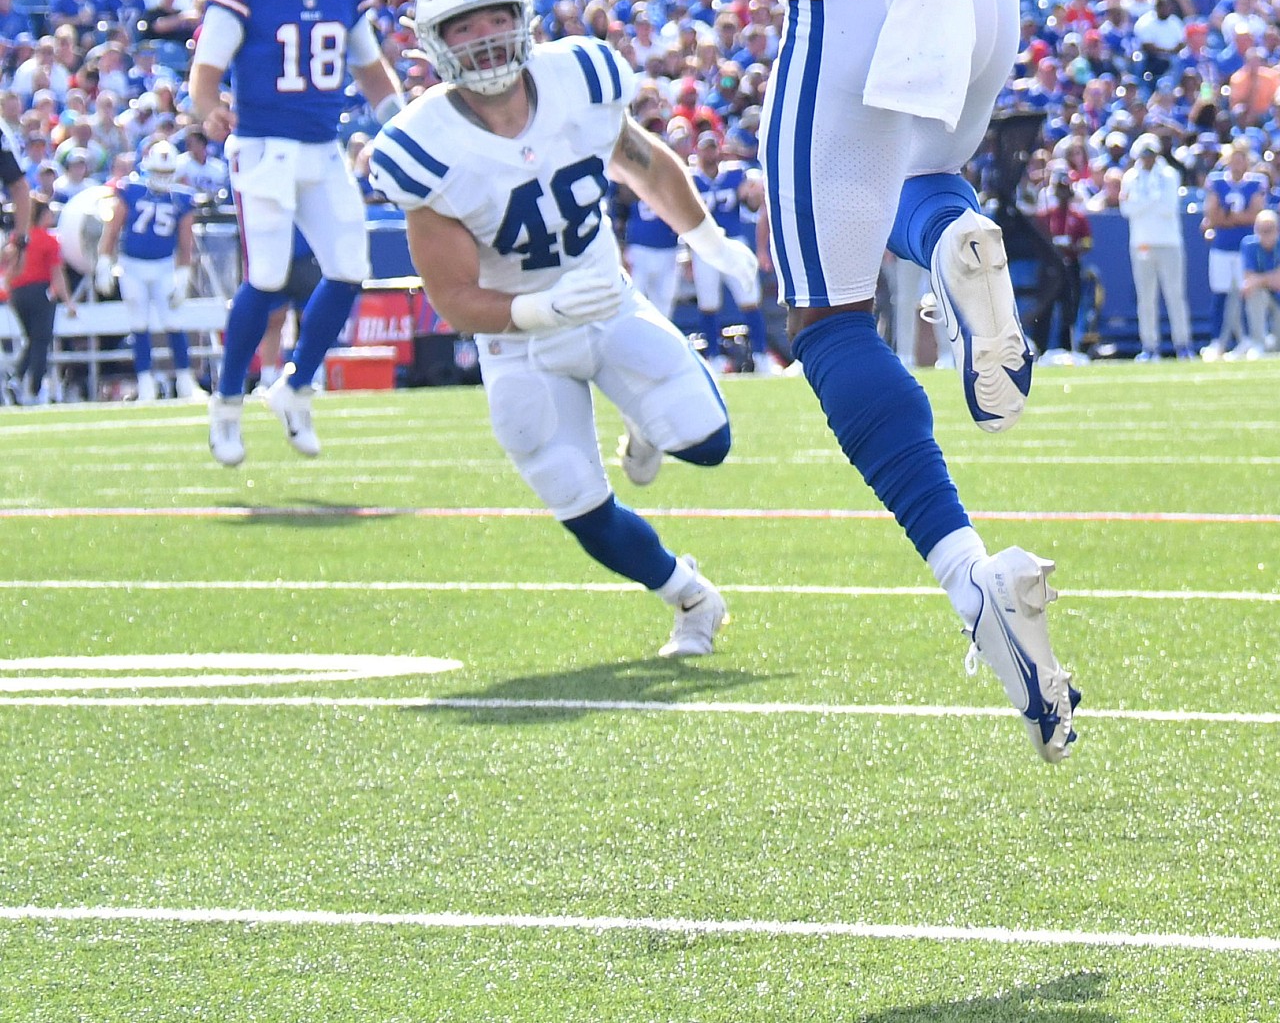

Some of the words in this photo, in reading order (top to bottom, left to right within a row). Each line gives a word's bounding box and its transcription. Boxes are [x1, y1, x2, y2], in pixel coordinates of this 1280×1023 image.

[275, 20, 348, 92] 18
[131, 199, 177, 237] 75
[492, 154, 609, 271] 48
[357, 315, 413, 341] BILLS
